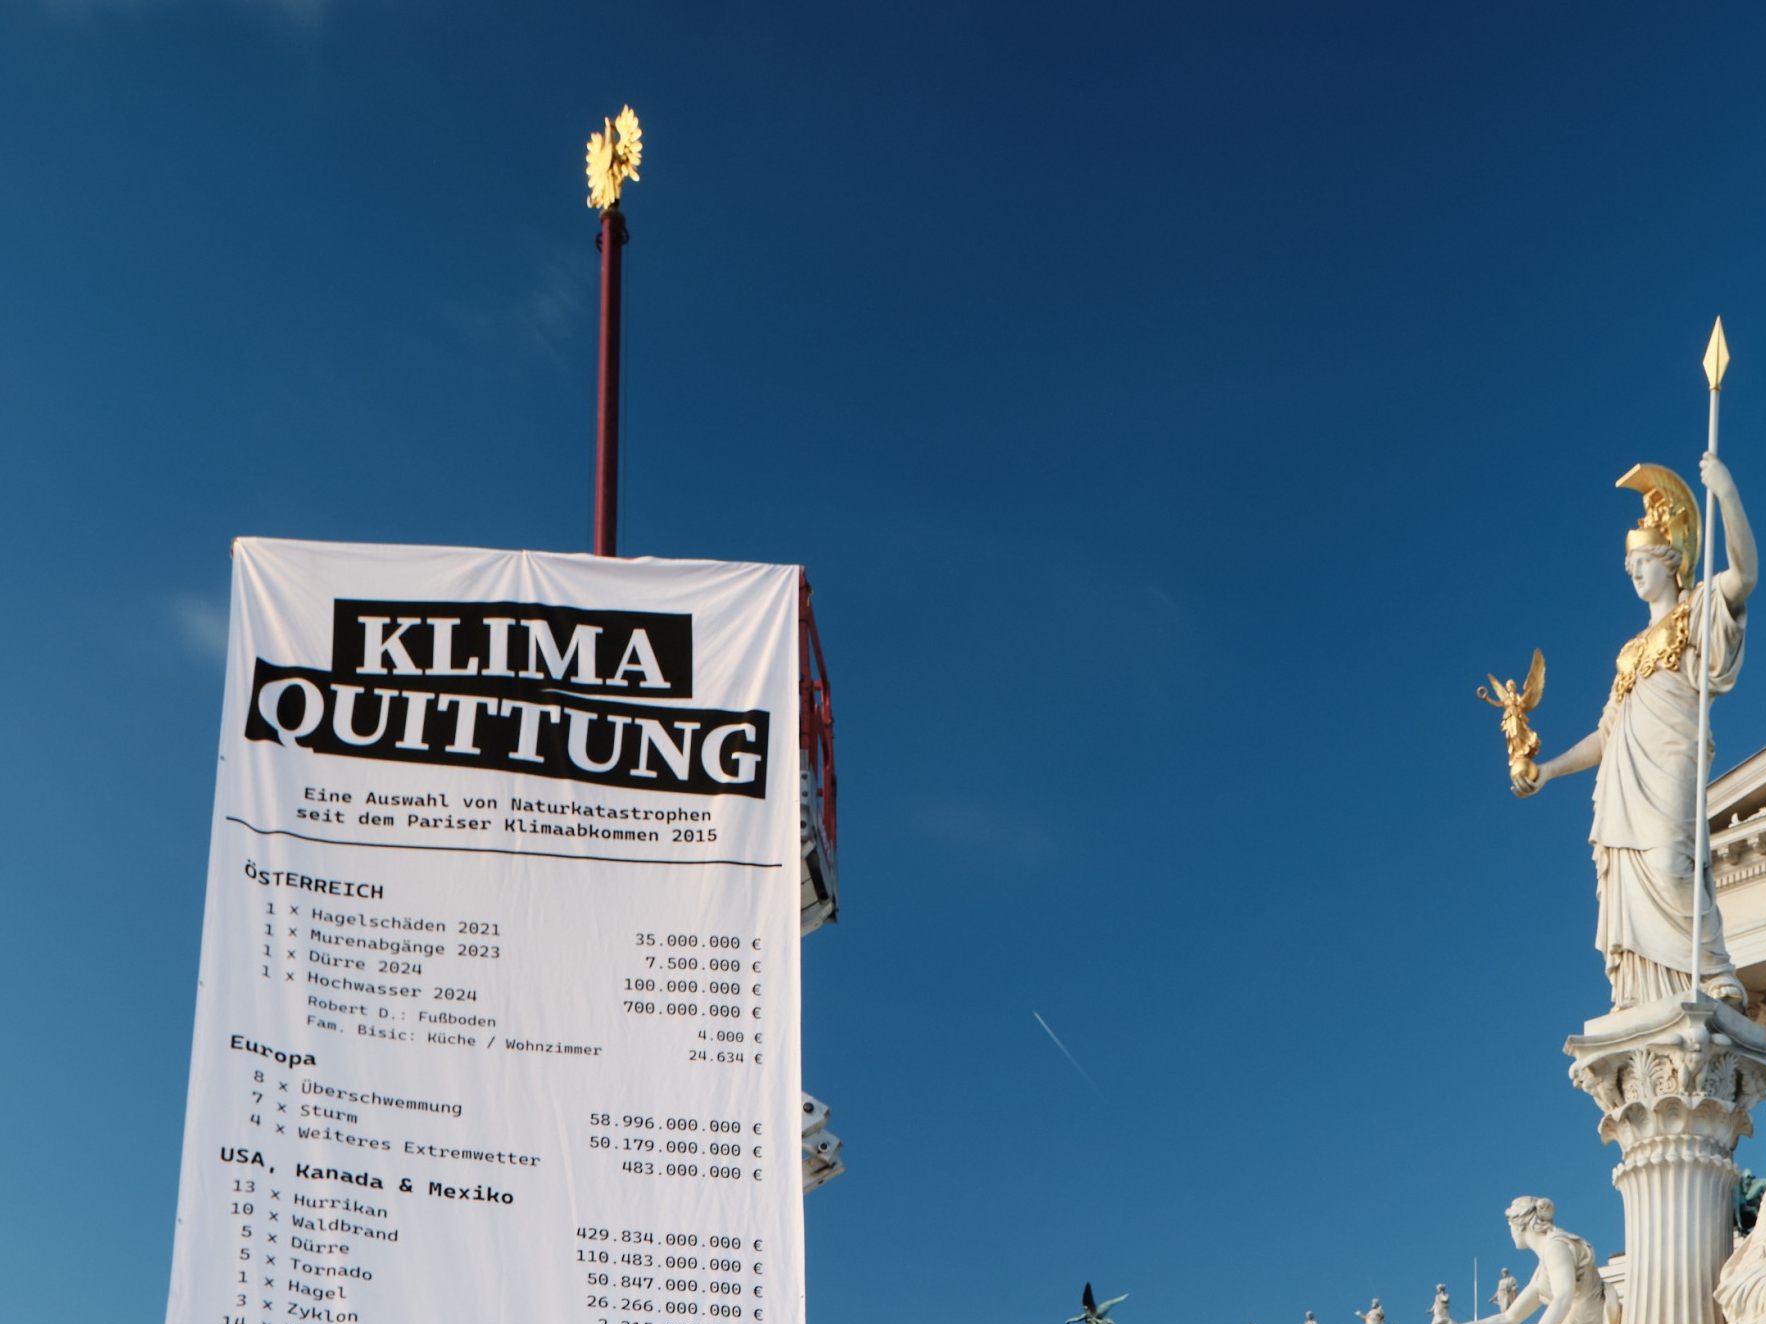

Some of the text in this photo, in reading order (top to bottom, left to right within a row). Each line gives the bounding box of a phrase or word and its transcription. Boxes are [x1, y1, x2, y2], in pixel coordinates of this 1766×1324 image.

[356, 616, 671, 689] KLIMA
[258, 677, 762, 785] QUITTUNG
[304, 787, 711, 824] Eine Auswahl von Naturkatastrophen
[296, 809, 717, 842] seit dem Pariser Klimaabkommen 2015
[245, 859, 383, 899] ÖSTERREICH
[266, 902, 500, 936] 1 Hagelschäden 2021
[265, 923, 500, 959] 1 Murenabgänge 2023
[636, 933, 761, 950] 35.000.000 €
[264, 944, 422, 975] 1 Dürre 2024
[645, 956, 761, 973] 7.500.000 €
[262, 965, 477, 1002] 1 Hochwasser 2024
[625, 978, 762, 996] 100.000.000 €
[308, 995, 496, 1028] Robert D.: Fußboden
[623, 1001, 762, 1019] 700.000.000 €
[231, 1034, 316, 1069] Europa
[307, 1015, 602, 1056] Fam. Bisic: Küche Wohnzimmer
[698, 1029, 763, 1044] 4.000 €
[689, 1050, 763, 1065] 24.634 €
[252, 1091, 358, 1124] 7 Sturm
[254, 1070, 462, 1117] 8 Überschwemmung
[250, 1114, 541, 1167] 4 Weiteres Extremwetter
[590, 1113, 762, 1135] 58.996.000.000 €
[590, 1136, 762, 1158] 50.179.000.000 €
[221, 1146, 514, 1204] USA, Kanada & Mexiko
[622, 1161, 762, 1181] 483.000.000 €
[233, 1179, 387, 1218] 13 Hurrikan
[231, 1202, 398, 1242] 10 Waldbrand
[241, 1225, 350, 1254] 5 Dürre
[576, 1227, 763, 1252] 429.834.000.000 €
[240, 1248, 372, 1281] 5 Tornado
[577, 1249, 763, 1275] 110.483.000.000 €
[238, 1270, 347, 1301] 1 Hagel
[587, 1273, 763, 1298] 50.847.000.000 €
[237, 1294, 358, 1323] 3 Zyklon
[587, 1295, 763, 1321] 26.266.000.000 €
